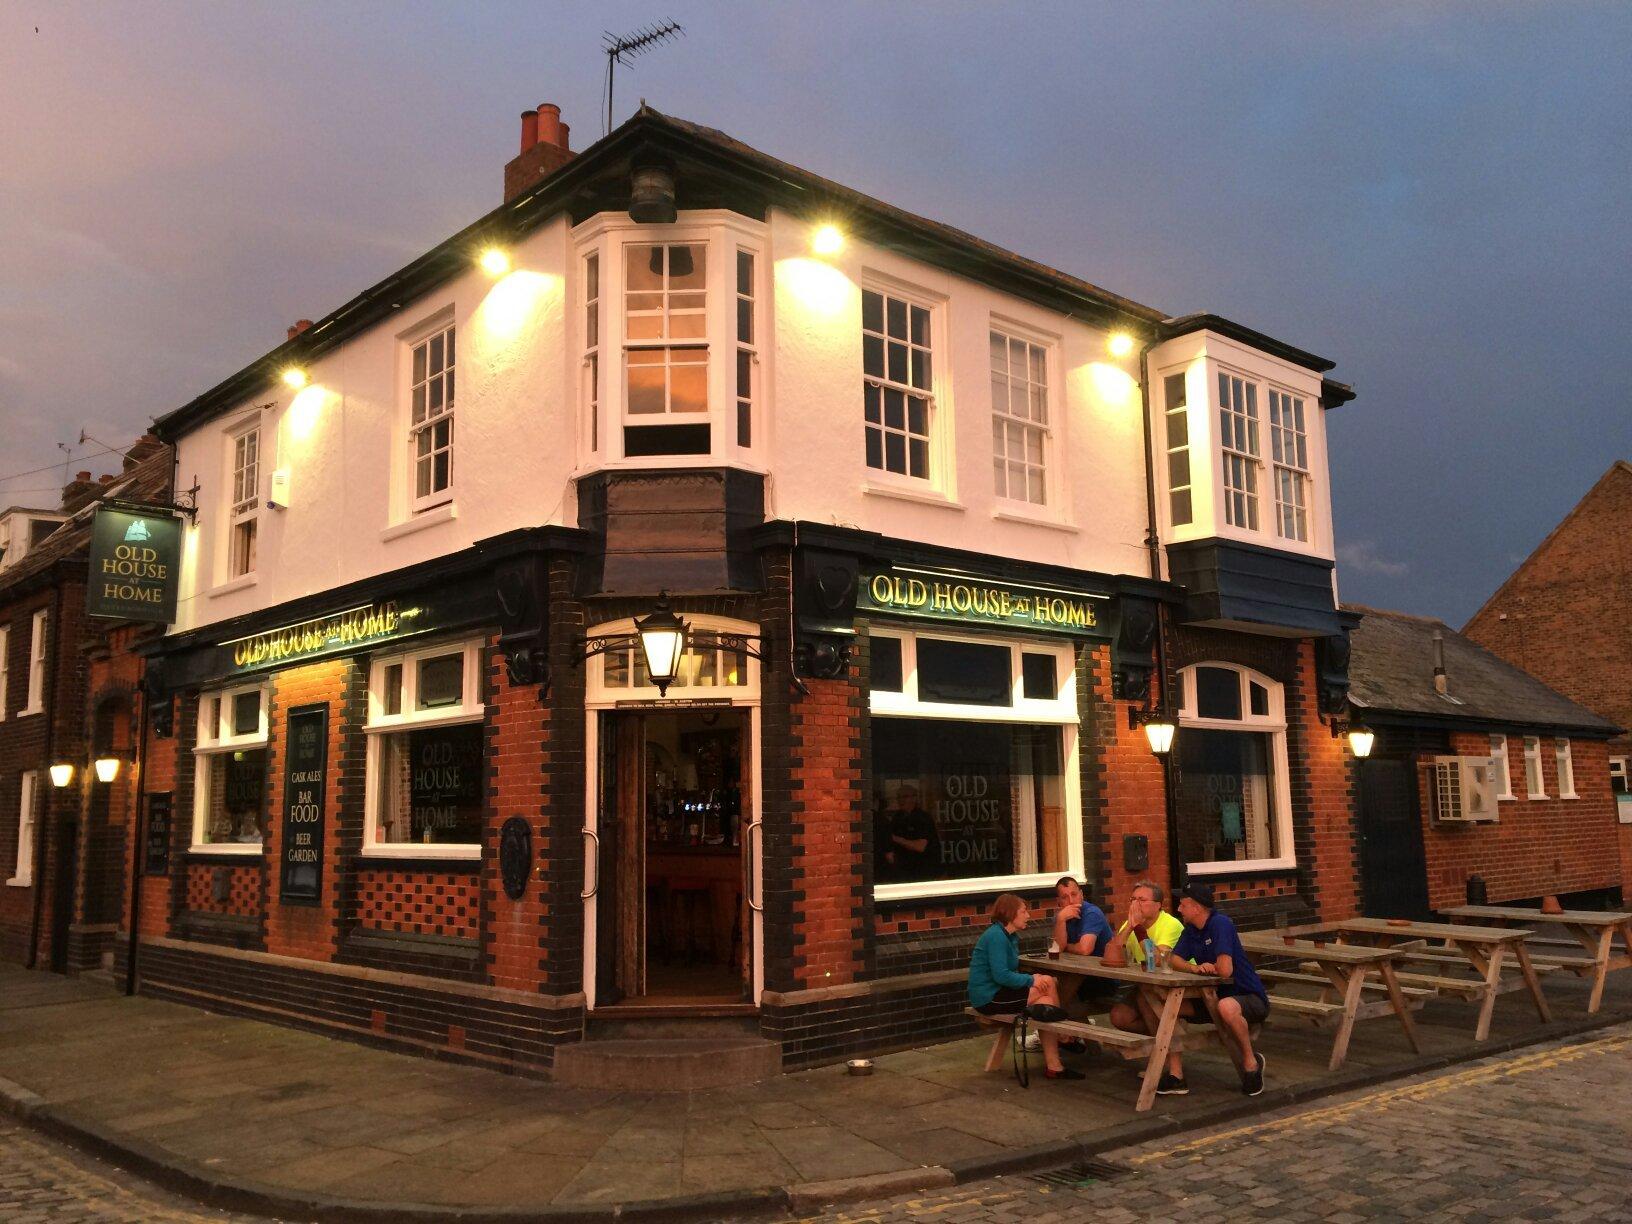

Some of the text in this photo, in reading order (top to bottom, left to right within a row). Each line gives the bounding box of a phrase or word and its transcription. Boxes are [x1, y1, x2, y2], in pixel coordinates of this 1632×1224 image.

[115, 545, 157, 562] OLD
[102, 559, 167, 579] HOUSE
[103, 583, 162, 603] HOME
[872, 575, 1097, 627] OLD HOUSE AT HOME
[234, 635, 267, 666] OLD
[268, 620, 325, 660] HOUSE
[339, 600, 398, 644] HOME
[422, 742, 452, 766] OLD
[291, 770, 321, 784] CASK ALES
[414, 766, 461, 791] HOUSE
[946, 775, 988, 797] OLD
[298, 790, 312, 804] BAR
[290, 804, 319, 823] FOOD
[415, 804, 457, 830] HOME
[936, 799, 1000, 824] HOUSE
[296, 833, 311, 846] BEER
[288, 848, 318, 862] GARDEN
[939, 838, 999, 864] HOME
